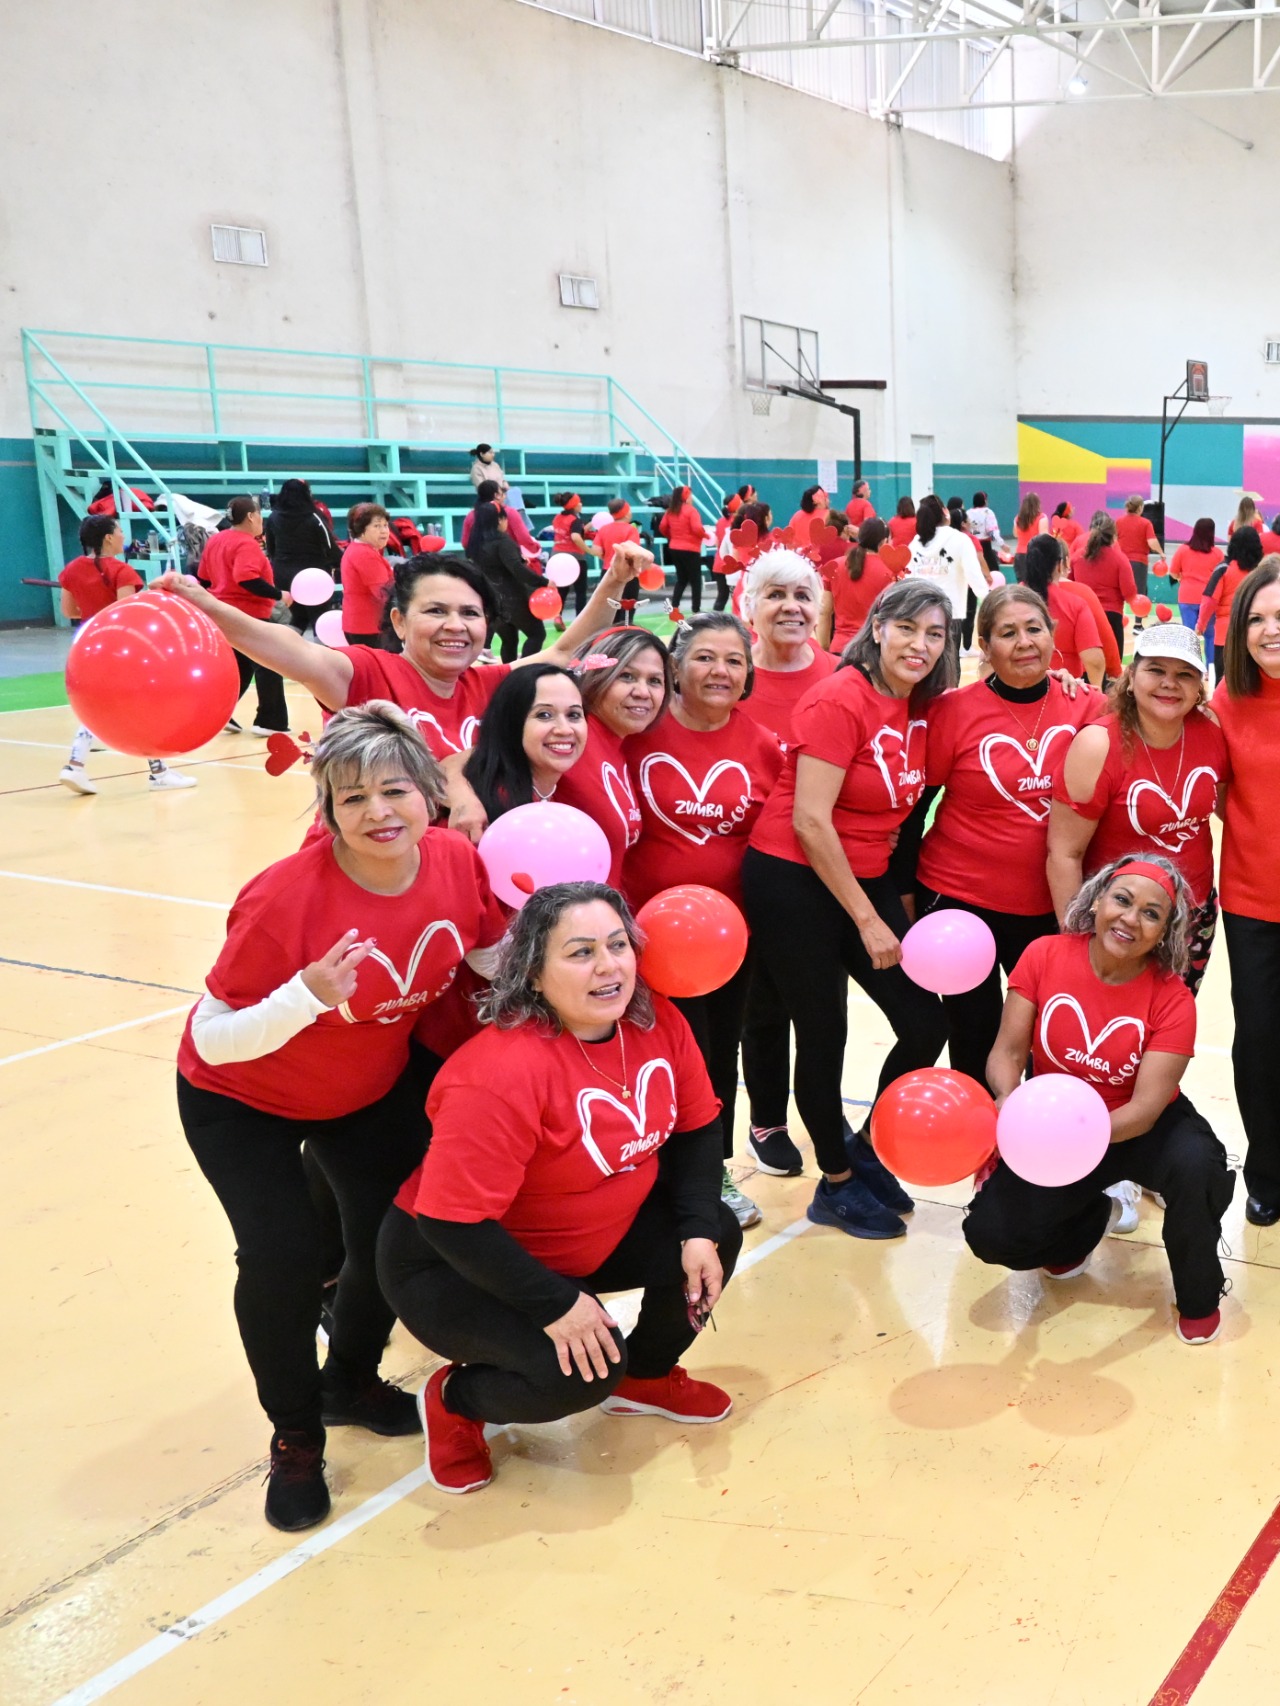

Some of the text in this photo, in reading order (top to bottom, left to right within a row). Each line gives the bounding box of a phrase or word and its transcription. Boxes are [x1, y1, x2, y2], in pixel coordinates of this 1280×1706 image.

[1017, 775, 1053, 792] ZUMB
[674, 800, 724, 819] ZUMBA
[372, 990, 429, 1016] ZUMBA
[1064, 1047, 1111, 1074] ZUMBA
[620, 1130, 660, 1162] ZUMBA
